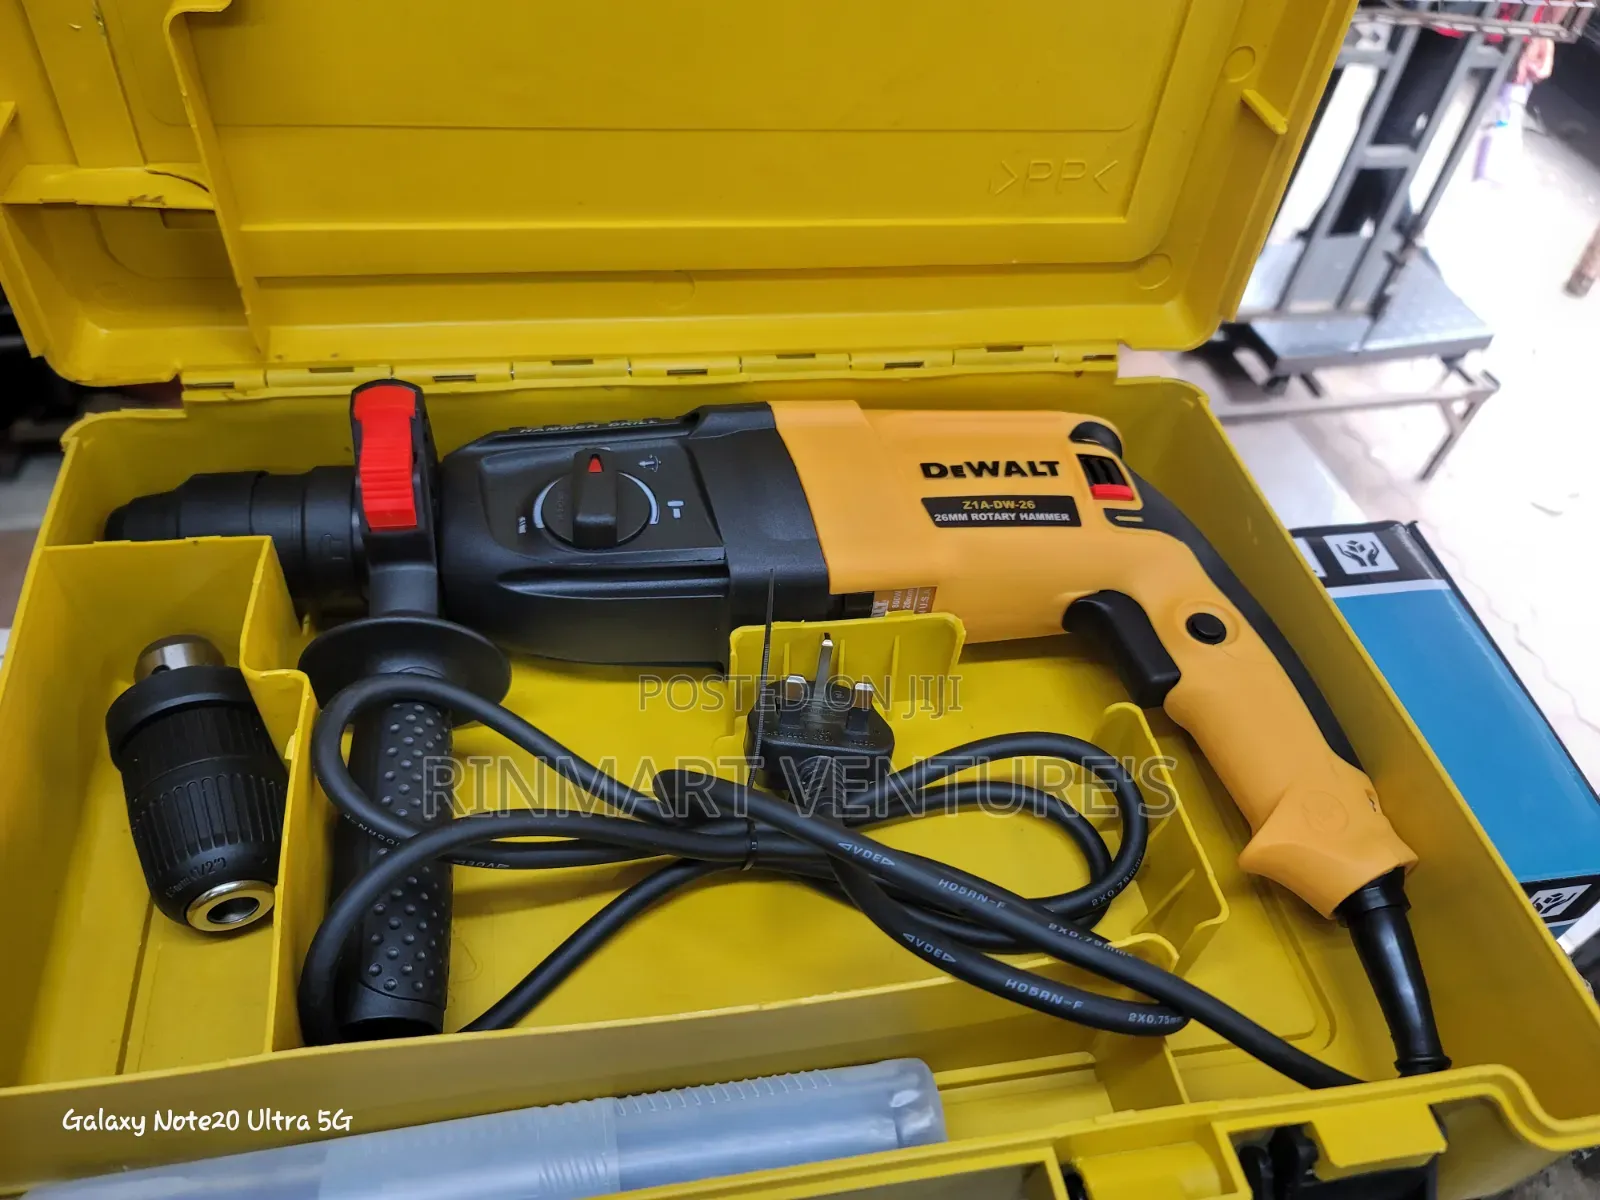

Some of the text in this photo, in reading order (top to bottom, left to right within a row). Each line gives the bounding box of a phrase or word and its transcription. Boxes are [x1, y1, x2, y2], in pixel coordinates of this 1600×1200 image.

[962, 500, 1036, 510] Z1A-DW-26
[934, 512, 1071, 522] 26MM ROTARY HAMMER
